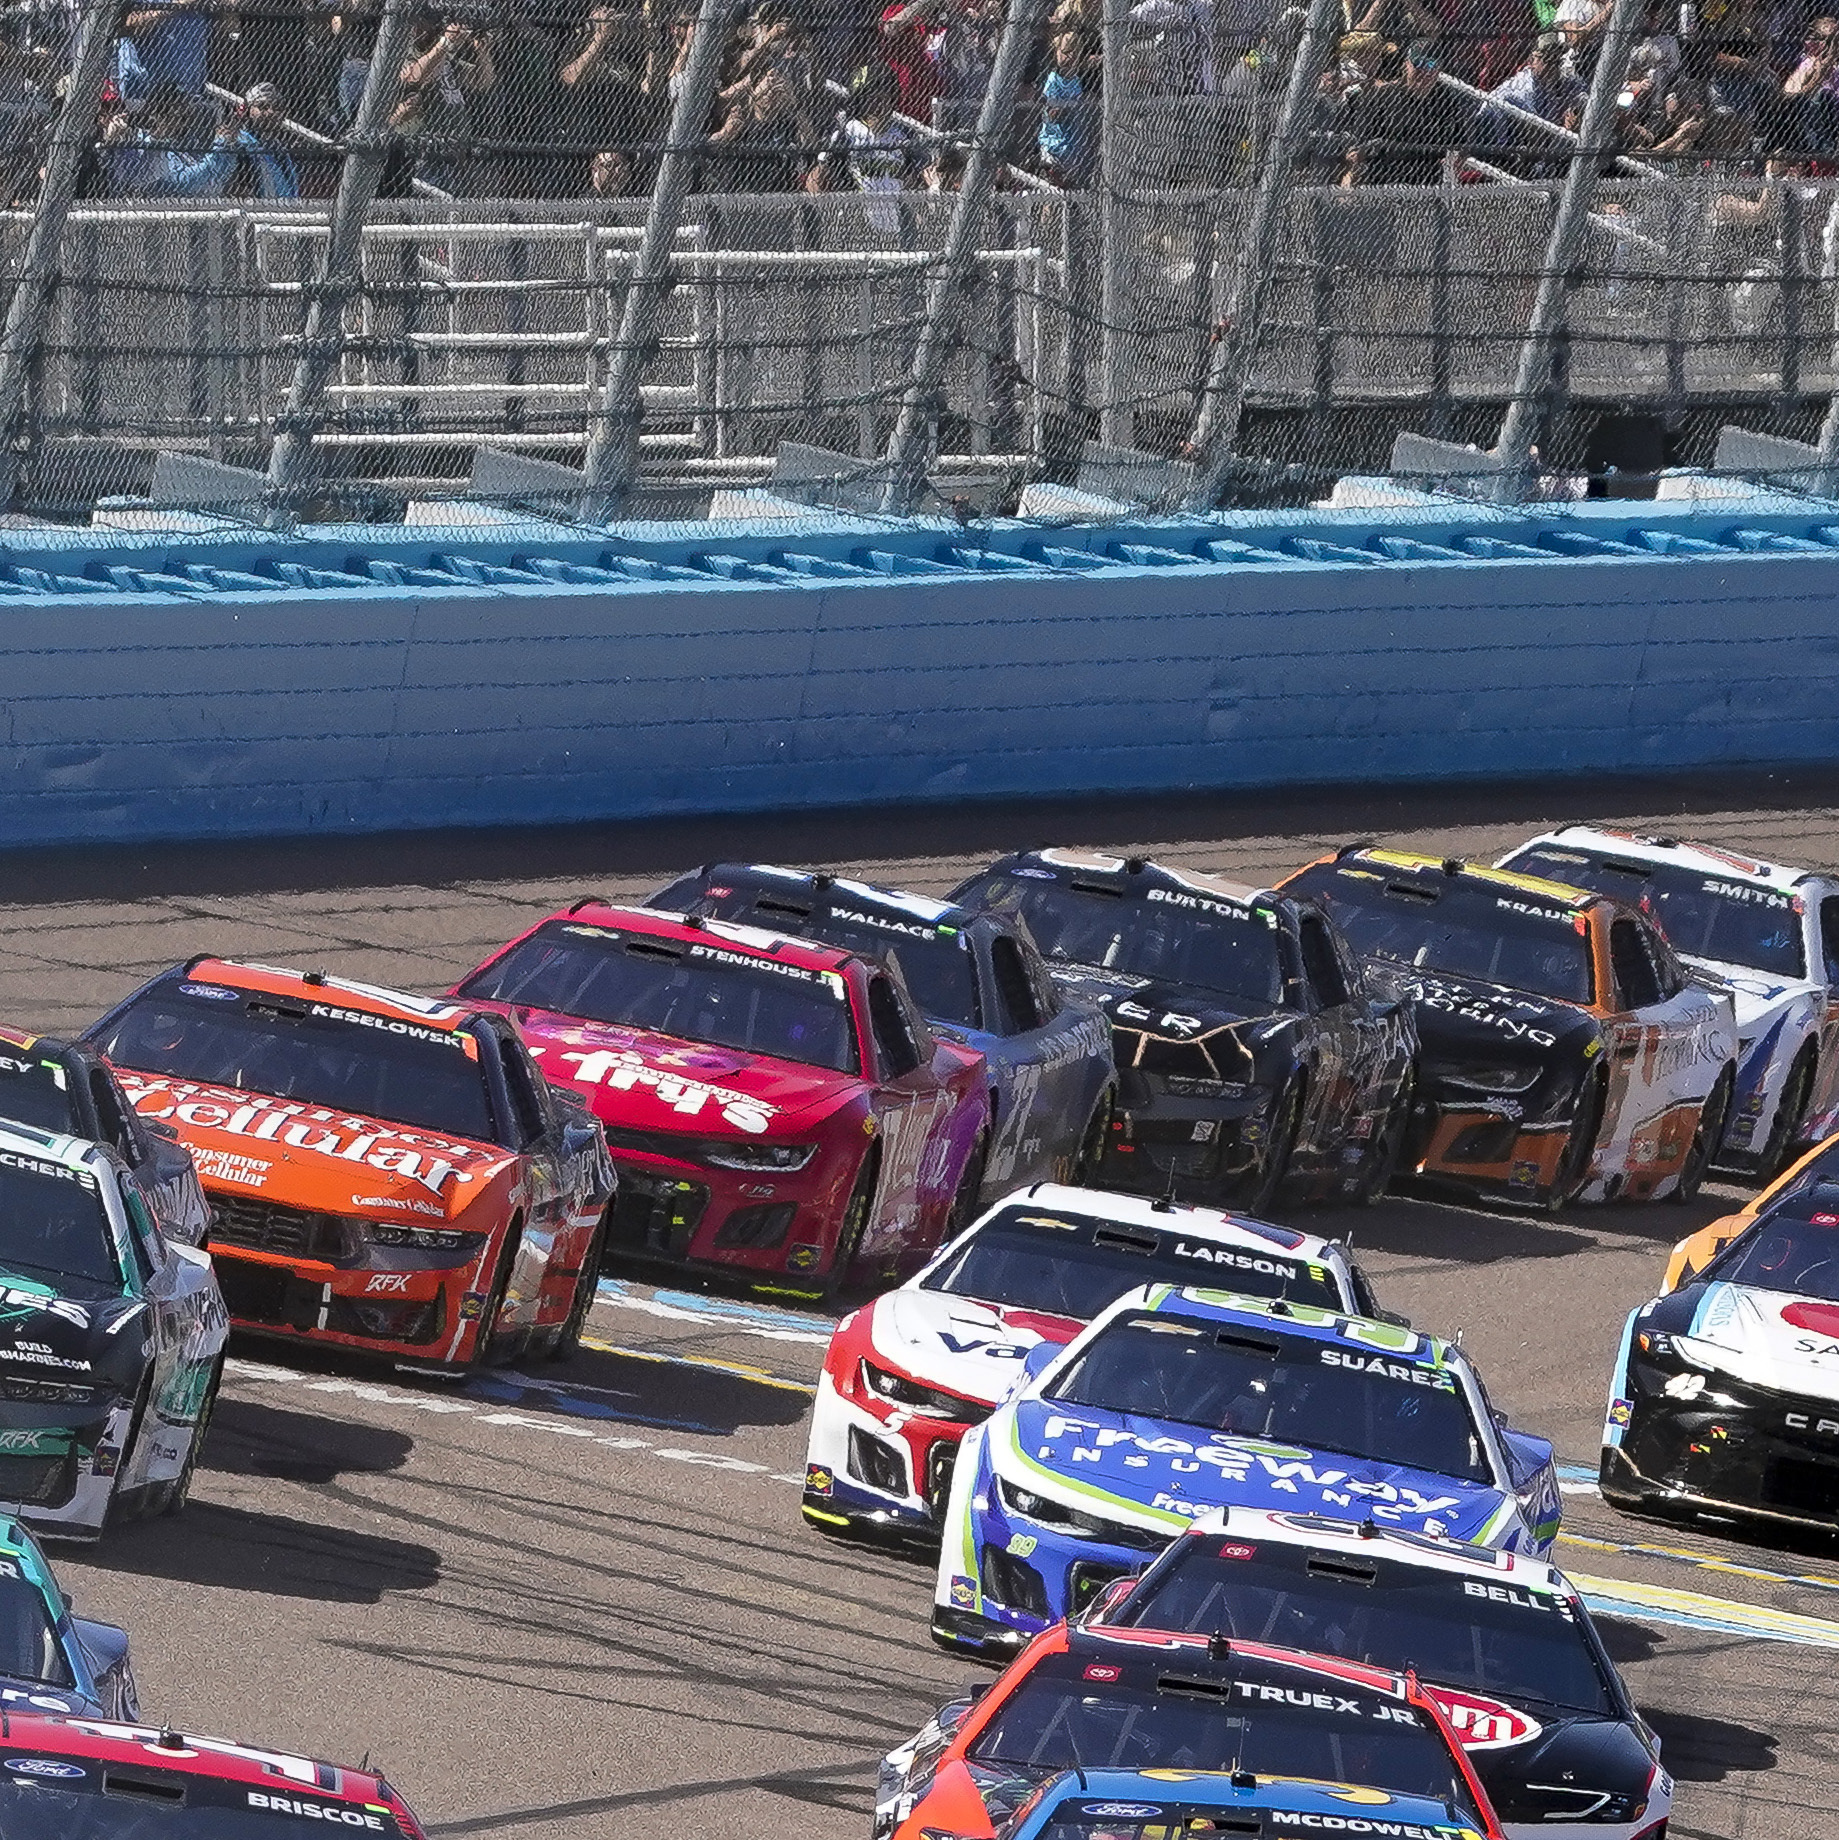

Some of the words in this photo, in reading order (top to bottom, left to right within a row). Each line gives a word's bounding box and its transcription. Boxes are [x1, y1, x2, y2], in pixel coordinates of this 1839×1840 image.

[1147, 889, 1250, 920] BURTON
[1704, 879, 1788, 908] SMITH
[830, 906, 936, 940] WALLACE
[690, 945, 811, 980] STENHOUSE
[312, 1005, 461, 1048] KESELOWSK
[1175, 1243, 1297, 1278] LARSON
[1321, 1350, 1452, 1388] SUÁREZ
[1043, 1415, 1460, 1514] Freeway
[1006, 1533, 1037, 1557] 99
[1464, 1580, 1545, 1611] BELL
[1235, 1682, 1361, 1714] TRUEX
[5, 1759, 85, 1777] Ford
[248, 1794, 385, 1831] BRISCOE
[1081, 1803, 1163, 1818] Ford
